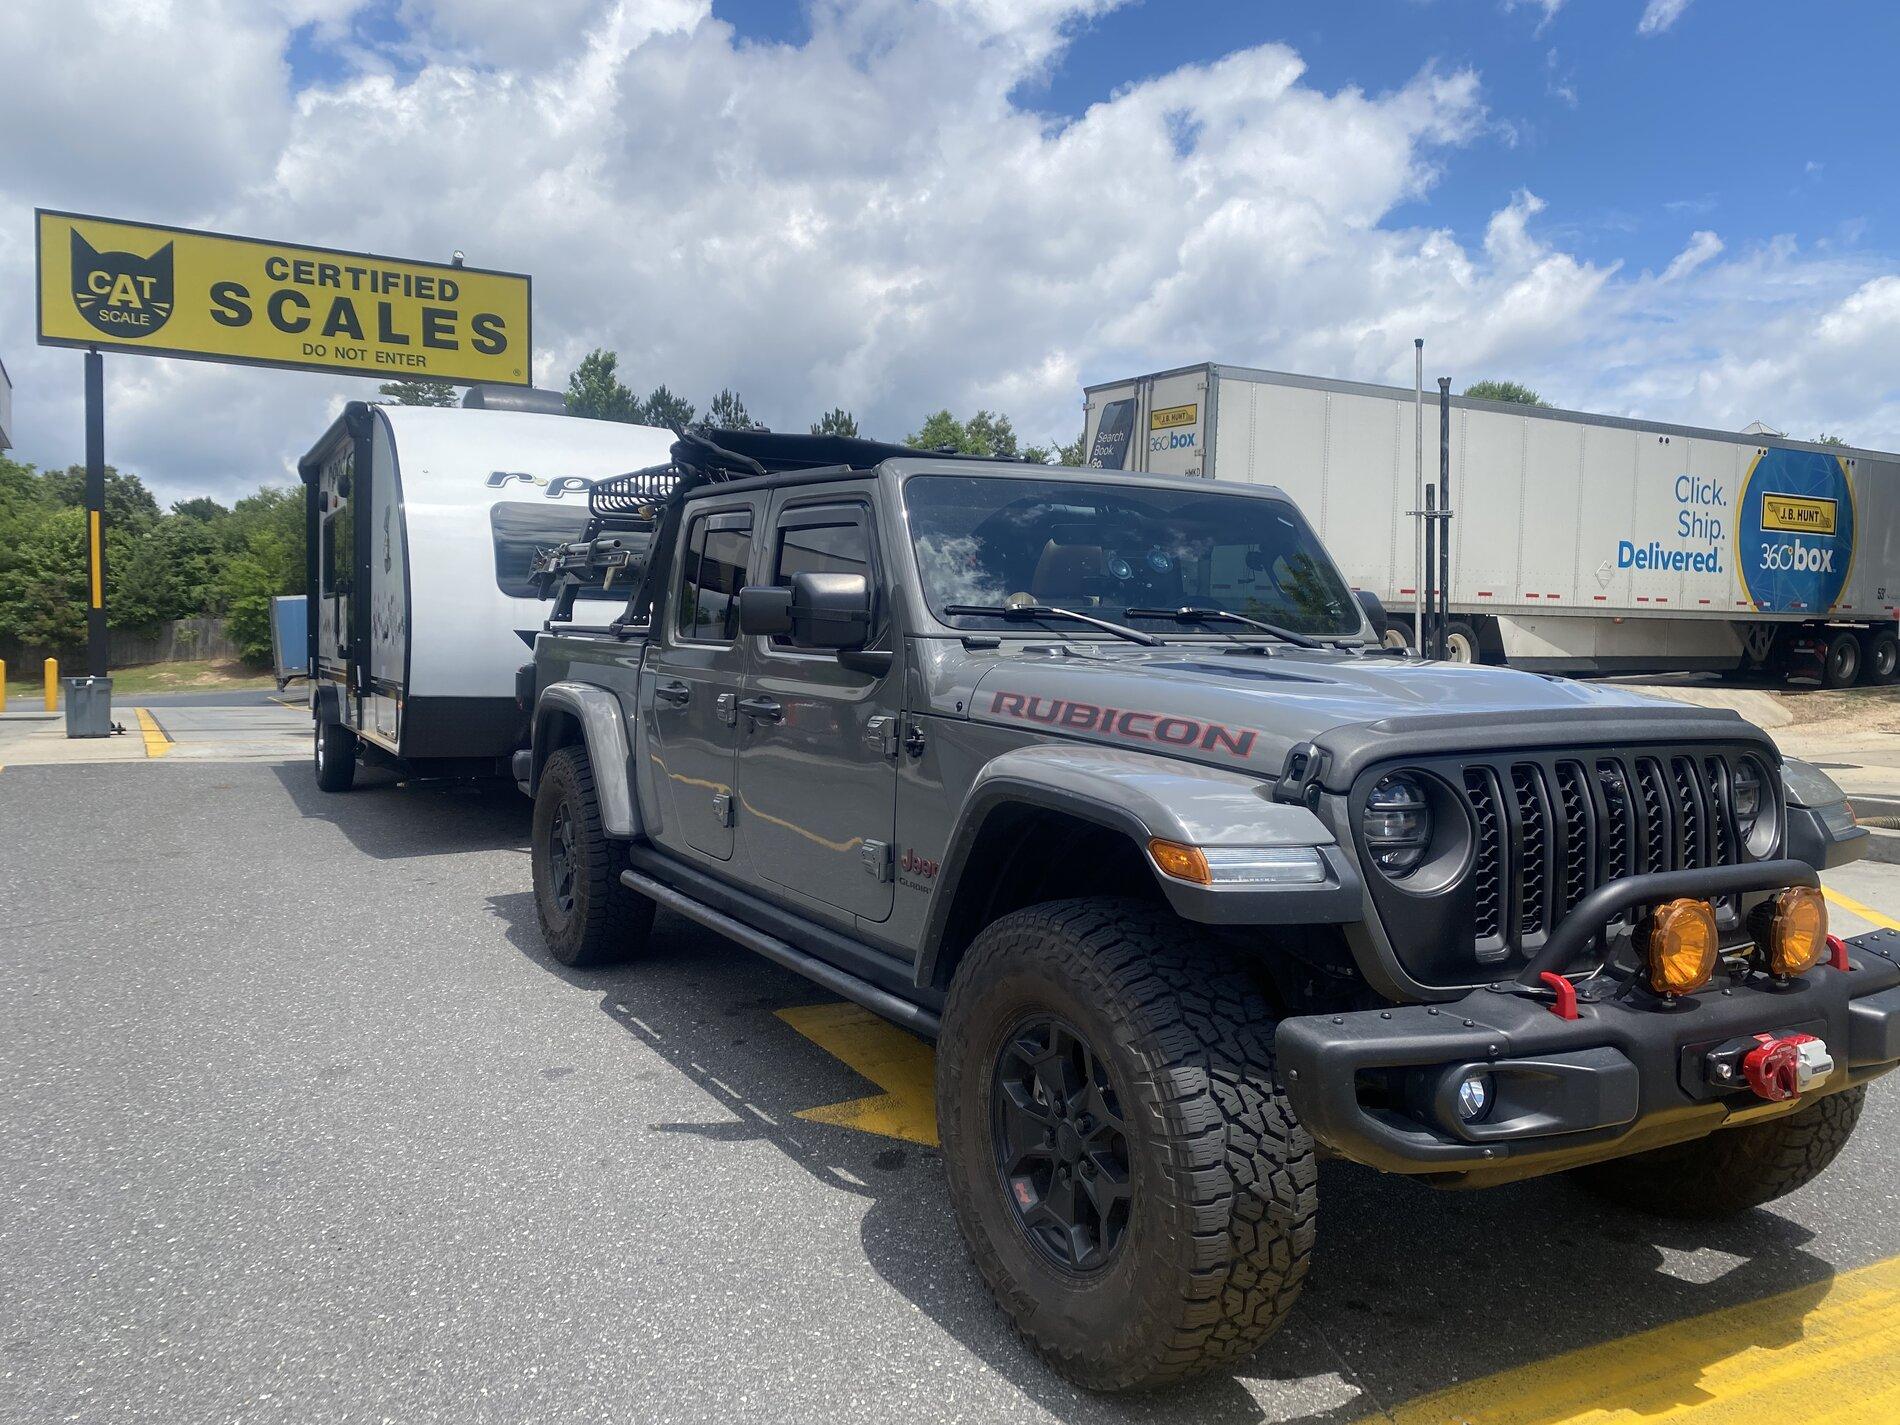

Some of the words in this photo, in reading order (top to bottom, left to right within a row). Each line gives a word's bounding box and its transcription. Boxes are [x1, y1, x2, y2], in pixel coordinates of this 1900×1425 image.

[87, 270, 157, 309] CAT
[264, 255, 460, 302] CERTIFIED
[98, 309, 151, 326] SCALE
[208, 280, 508, 356] SCALES
[302, 342, 327, 358] DO
[334, 345, 368, 361] NOT
[375, 350, 427, 368] ENTER
[1171, 412, 1186, 421] HUNT
[1097, 430, 1125, 443] Search.
[1091, 457, 1104, 469] Go.
[1675, 475, 1727, 507] Click.
[1677, 510, 1726, 546] Ship.
[1780, 507, 1796, 521] J.B.
[1797, 508, 1820, 523] HUNT
[1617, 540, 1724, 574] Delivered.
[989, 690, 1261, 759] RUBICON
